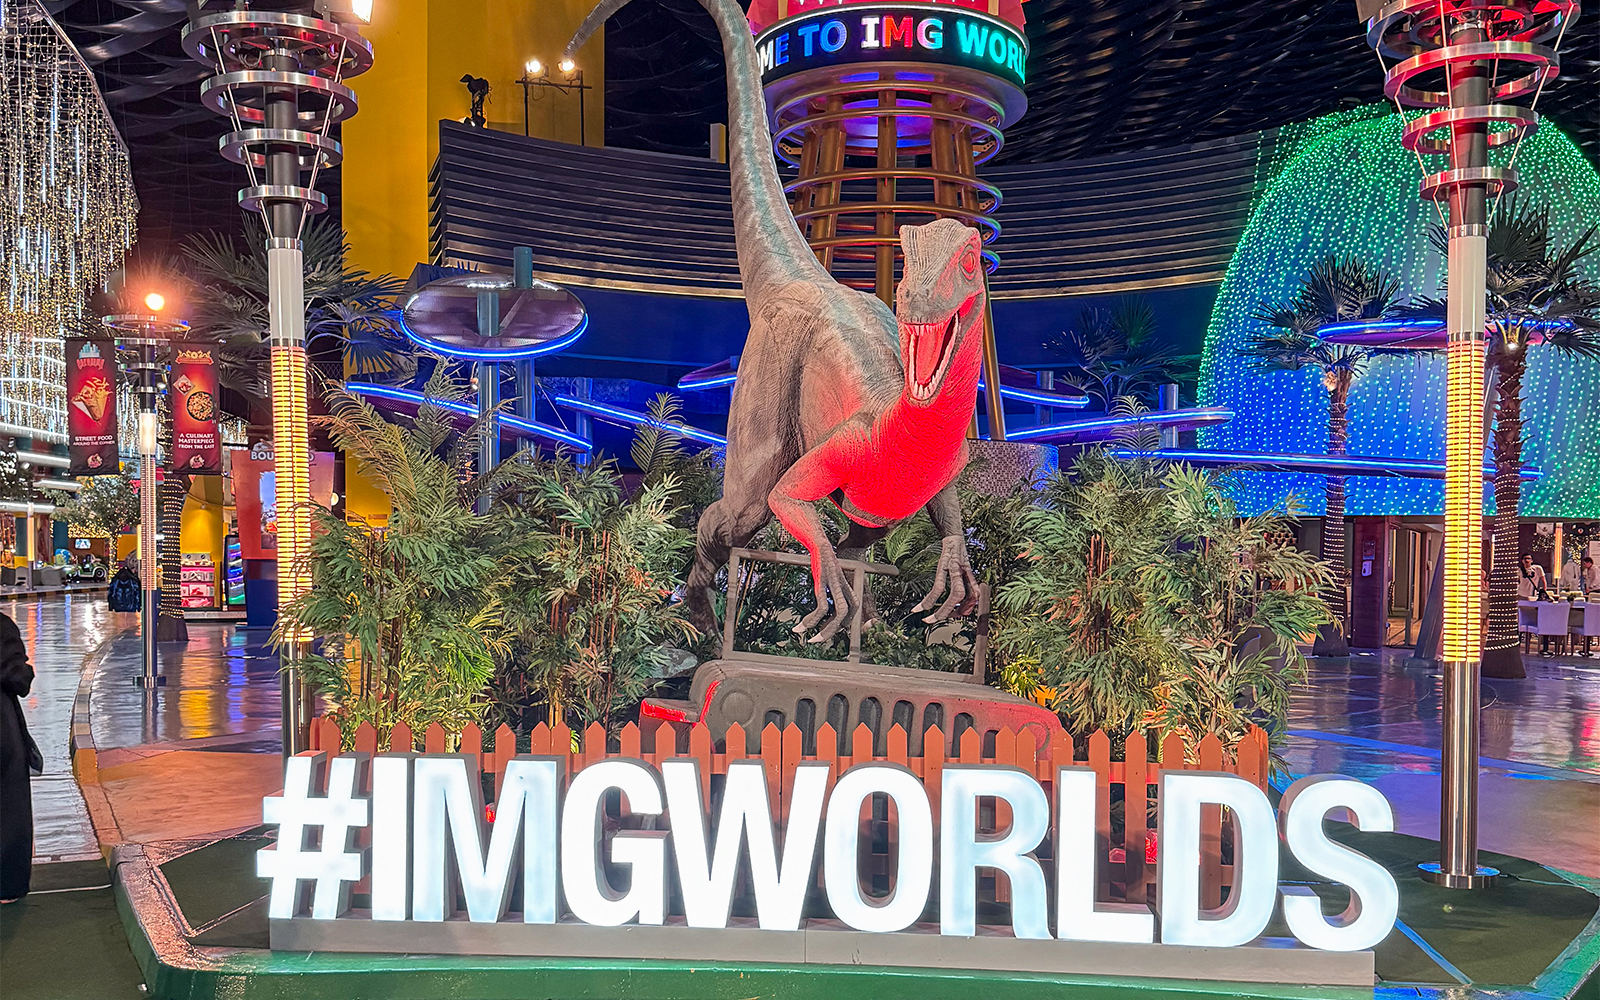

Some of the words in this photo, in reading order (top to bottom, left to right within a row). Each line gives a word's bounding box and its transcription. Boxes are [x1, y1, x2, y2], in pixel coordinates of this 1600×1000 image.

[798, 19, 847, 57] TO
[861, 15, 943, 50] IMG
[256, 754, 1399, 952] #IMGWORLDS
